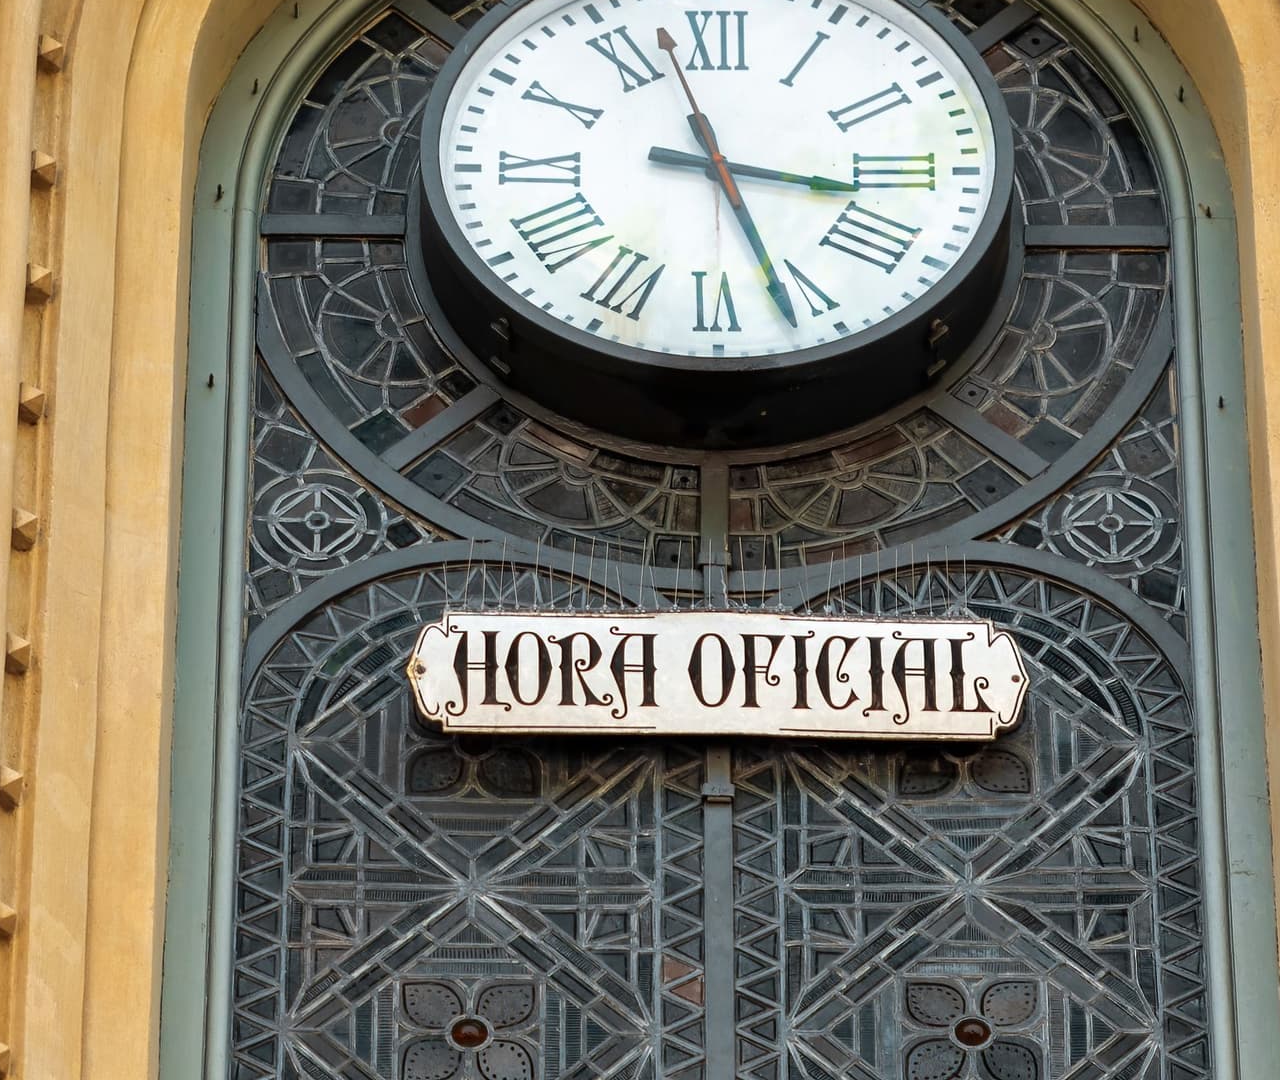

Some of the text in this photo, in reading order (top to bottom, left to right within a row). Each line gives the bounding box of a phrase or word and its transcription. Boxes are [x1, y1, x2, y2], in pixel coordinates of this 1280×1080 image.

[586, 26, 665, 92] XI
[685, 10, 749, 71] XII
[779, 32, 830, 87] I
[522, 81, 605, 130] X
[827, 83, 913, 133] II
[499, 151, 580, 187] IX
[853, 152, 935, 191] III
[819, 201, 923, 274] IIII
[580, 246, 666, 321] VII
[692, 271, 742, 332] VI
[784, 259, 840, 317] V
[446, 625, 997, 725] HORA OFICIAL
